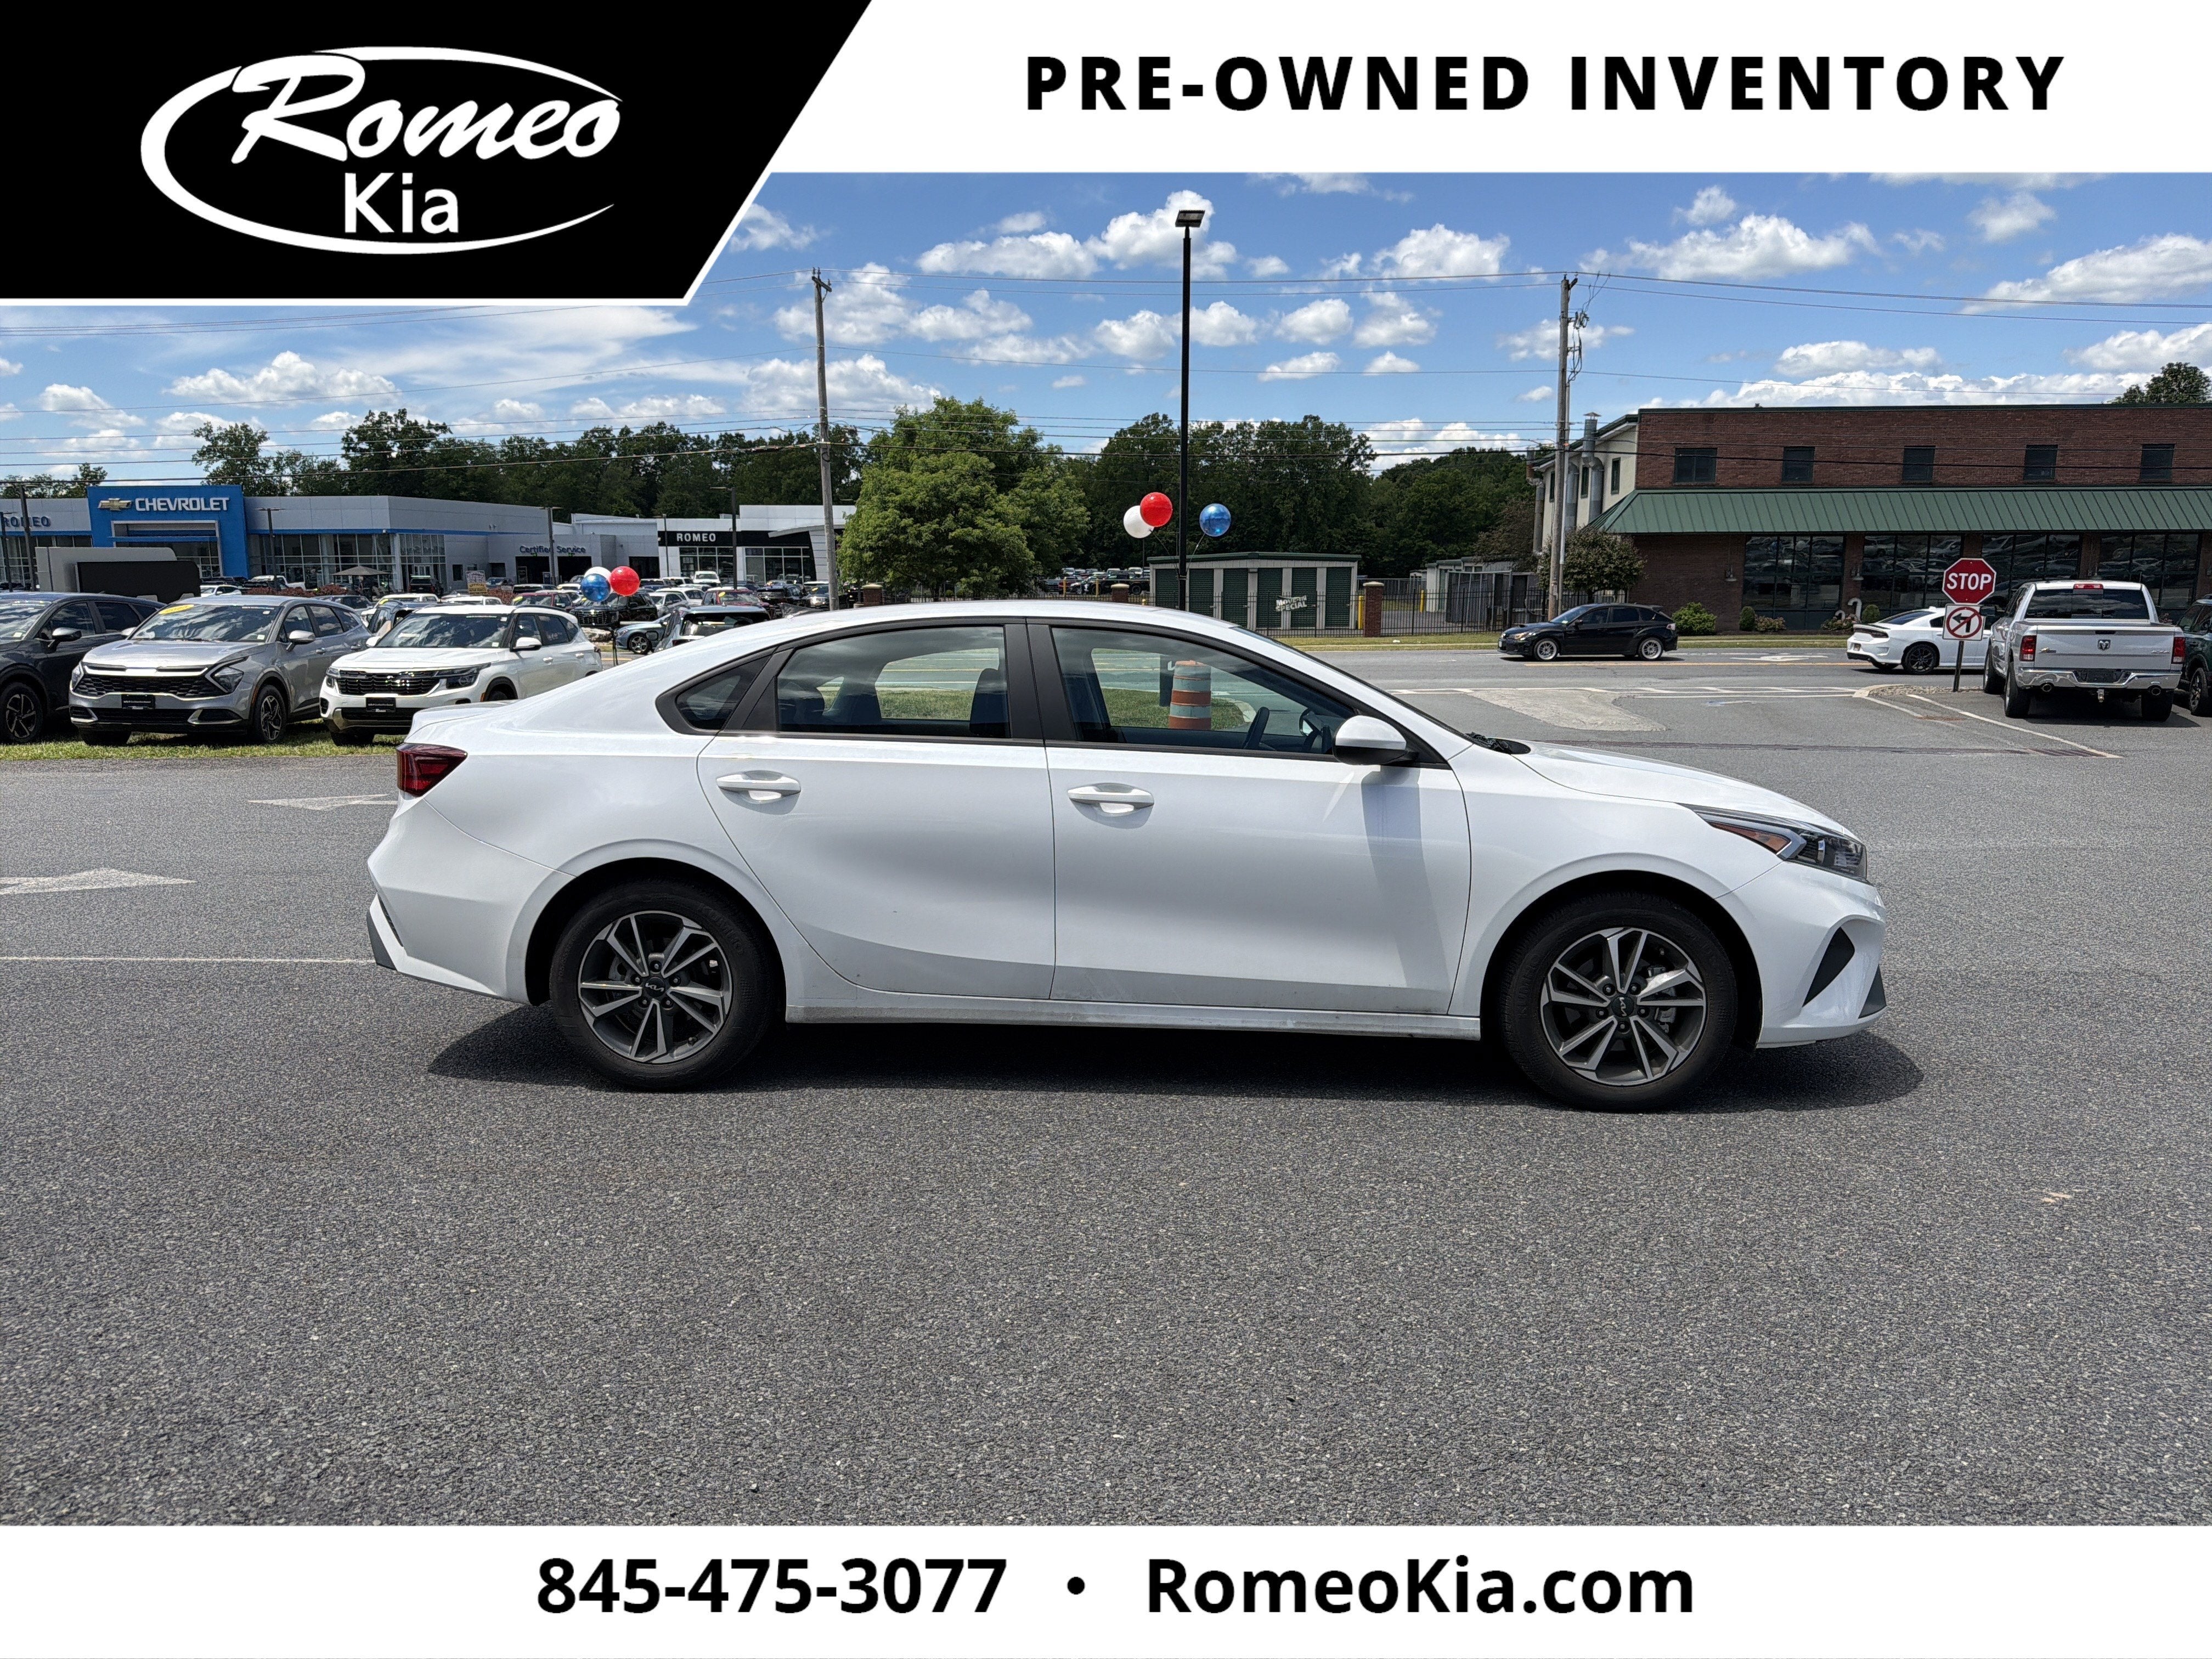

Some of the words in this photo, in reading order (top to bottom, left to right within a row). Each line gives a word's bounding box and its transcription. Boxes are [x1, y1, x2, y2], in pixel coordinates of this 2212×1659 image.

[135, 498, 229, 511] CHEVROLET
[676, 533, 716, 542] ROMEO
[1946, 572, 1991, 590] STOP
[1276, 601, 1307, 612] SPECIAL
